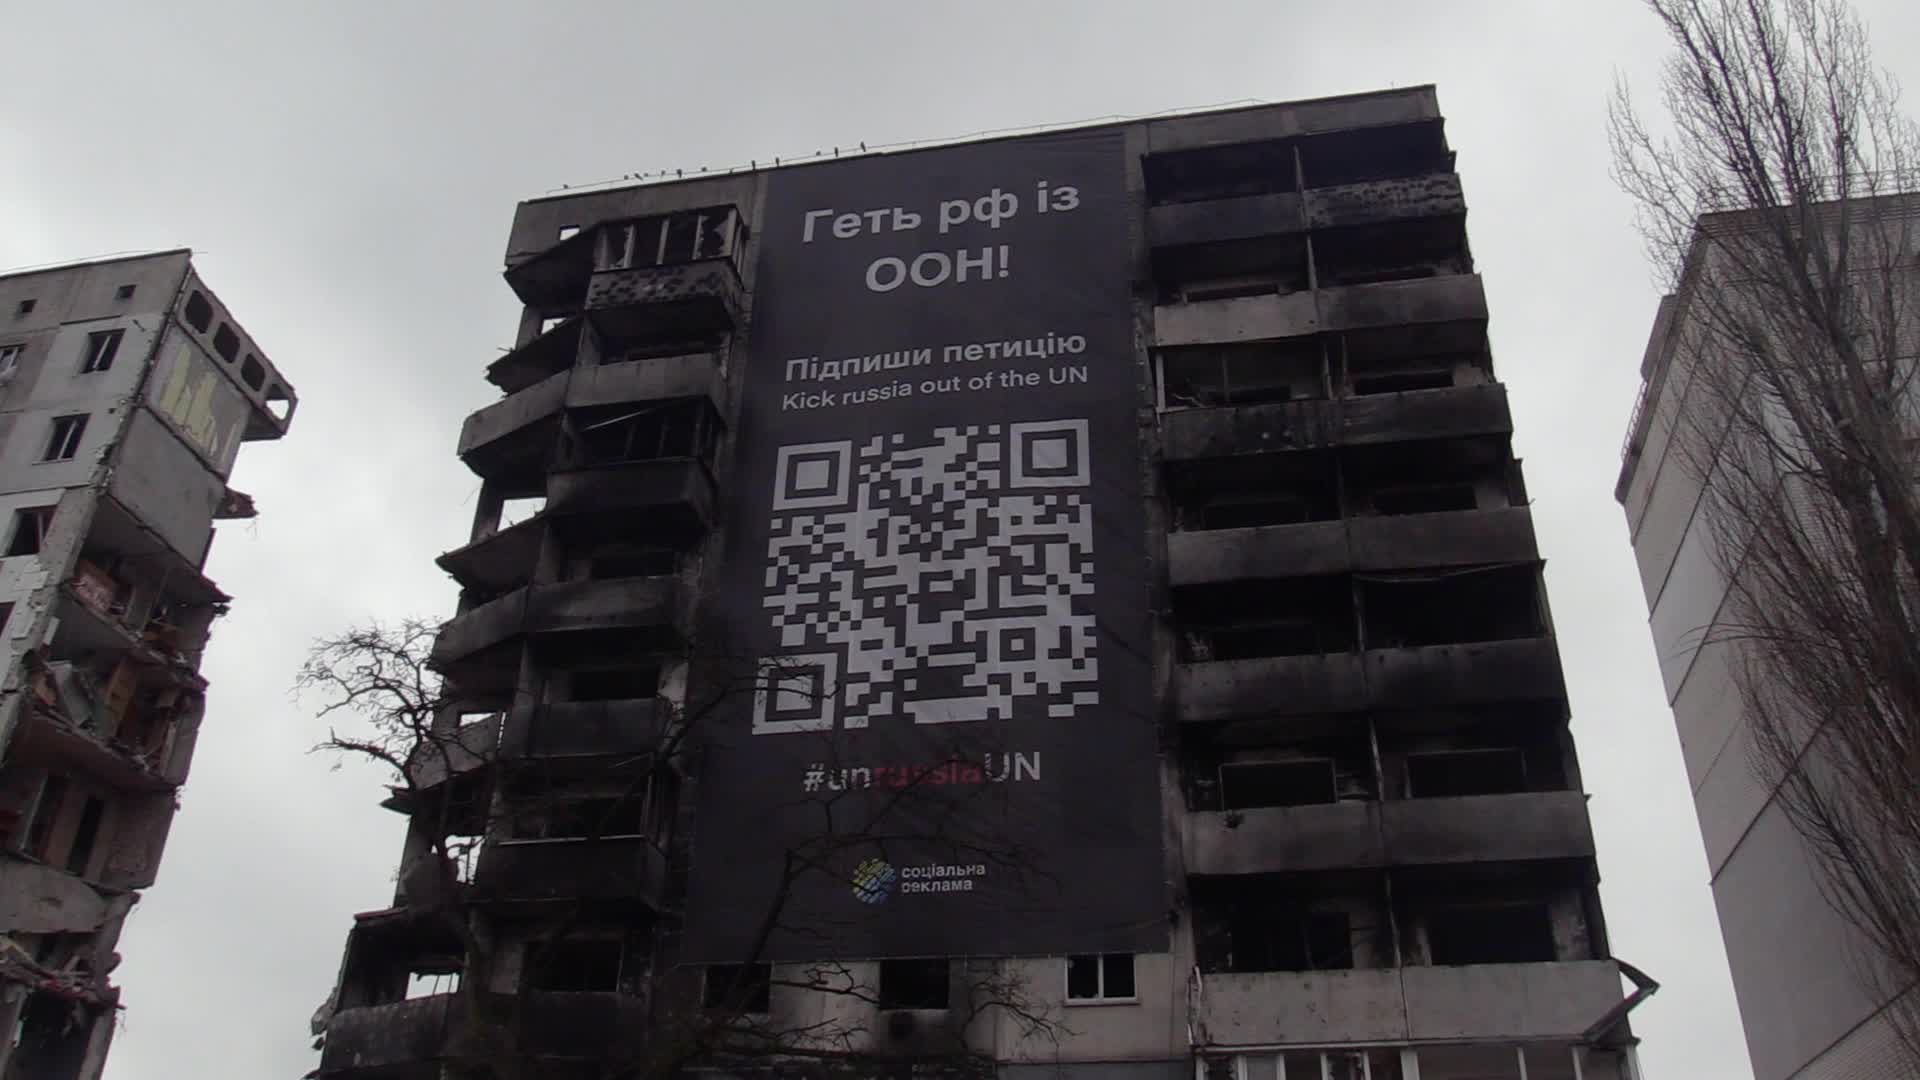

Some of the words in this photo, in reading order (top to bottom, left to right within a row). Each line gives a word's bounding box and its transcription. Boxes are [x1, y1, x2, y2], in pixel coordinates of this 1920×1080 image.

[802, 207, 922, 243] Геть
[938, 188, 1019, 234] рф
[1037, 181, 1081, 213] із
[865, 245, 1010, 292] ООН!
[785, 348, 932, 382] Підпиши
[943, 332, 1087, 363] петицію
[782, 392, 836, 411] Kick
[842, 381, 913, 406] russia
[920, 374, 961, 395] out
[968, 371, 993, 391] of
[1000, 368, 1041, 388] the
[1048, 366, 1088, 384] UN
[901, 863, 986, 880] соціальна
